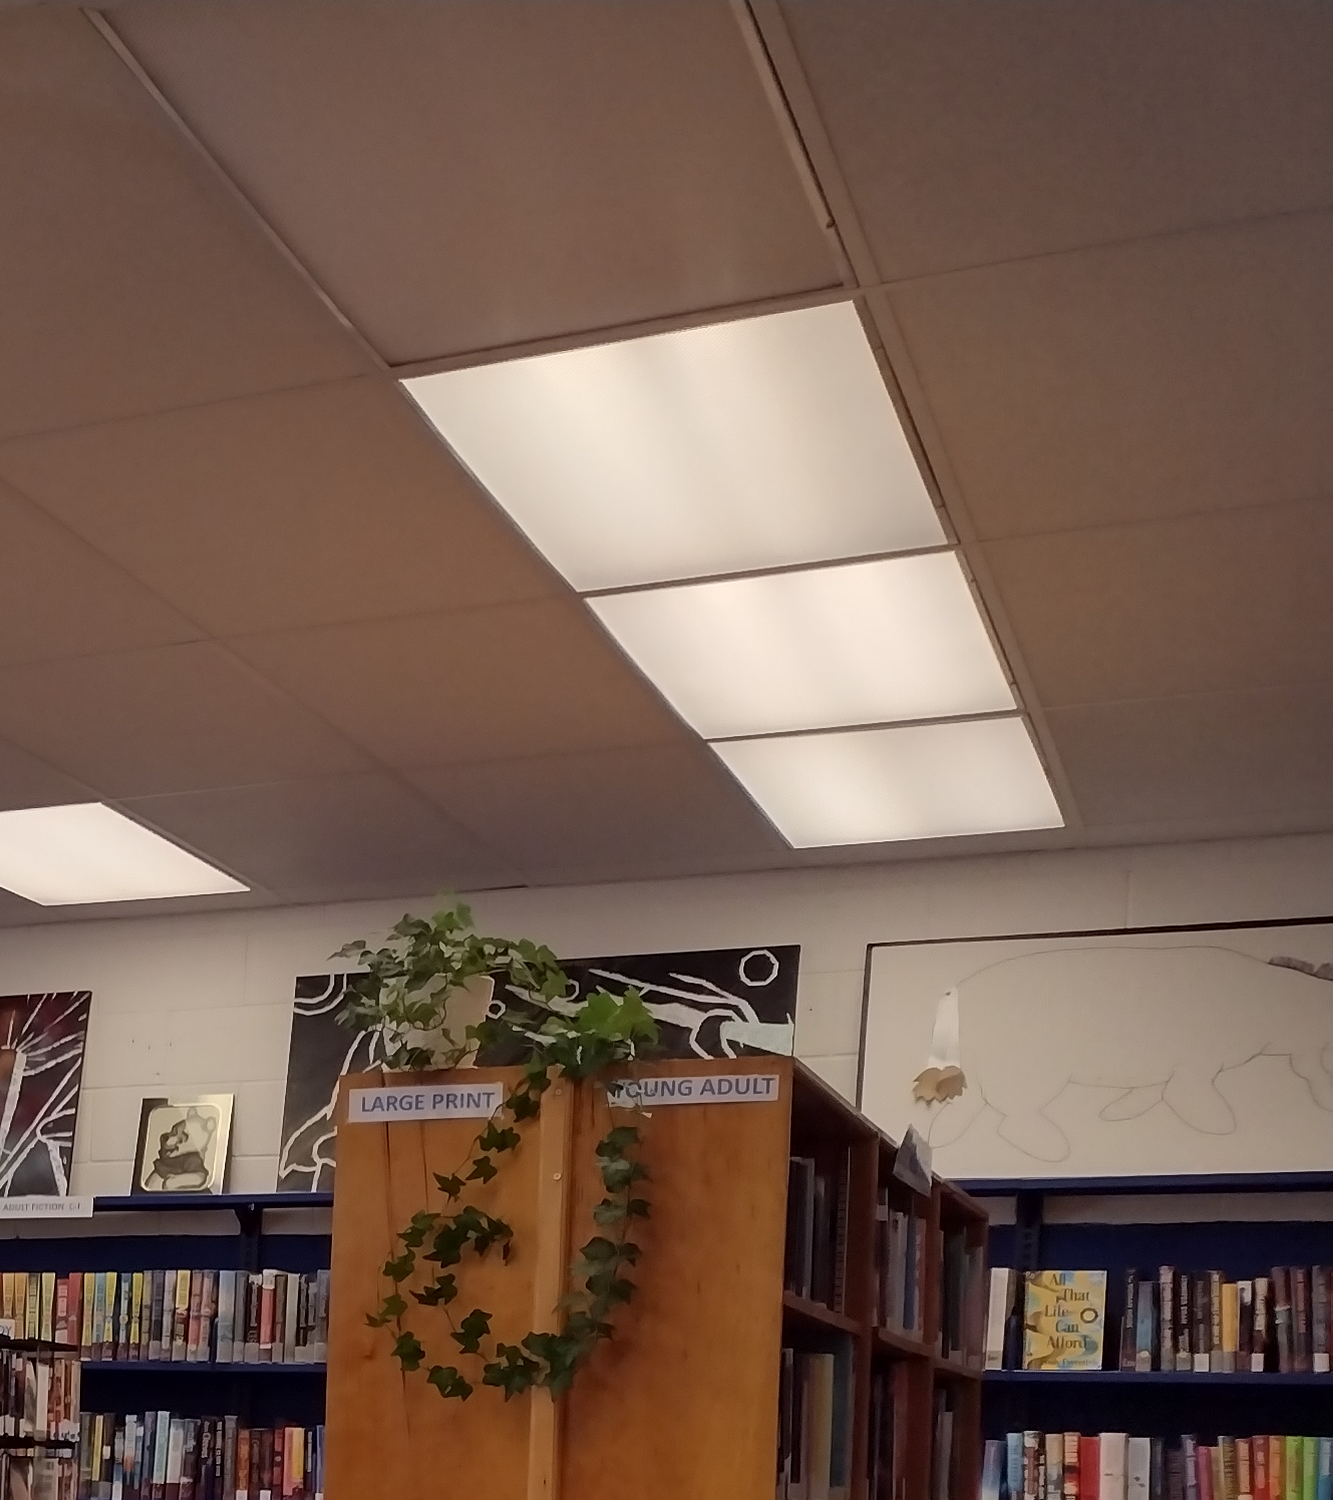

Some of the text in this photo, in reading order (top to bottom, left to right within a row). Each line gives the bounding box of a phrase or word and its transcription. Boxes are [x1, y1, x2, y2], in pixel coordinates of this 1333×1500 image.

[700, 1078, 776, 1096] ADULT
[361, 1092, 495, 1114] LARGE PRINT
[3, 1203, 64, 1212] ADULT FICTION
[1055, 1319, 1079, 1333] Can
